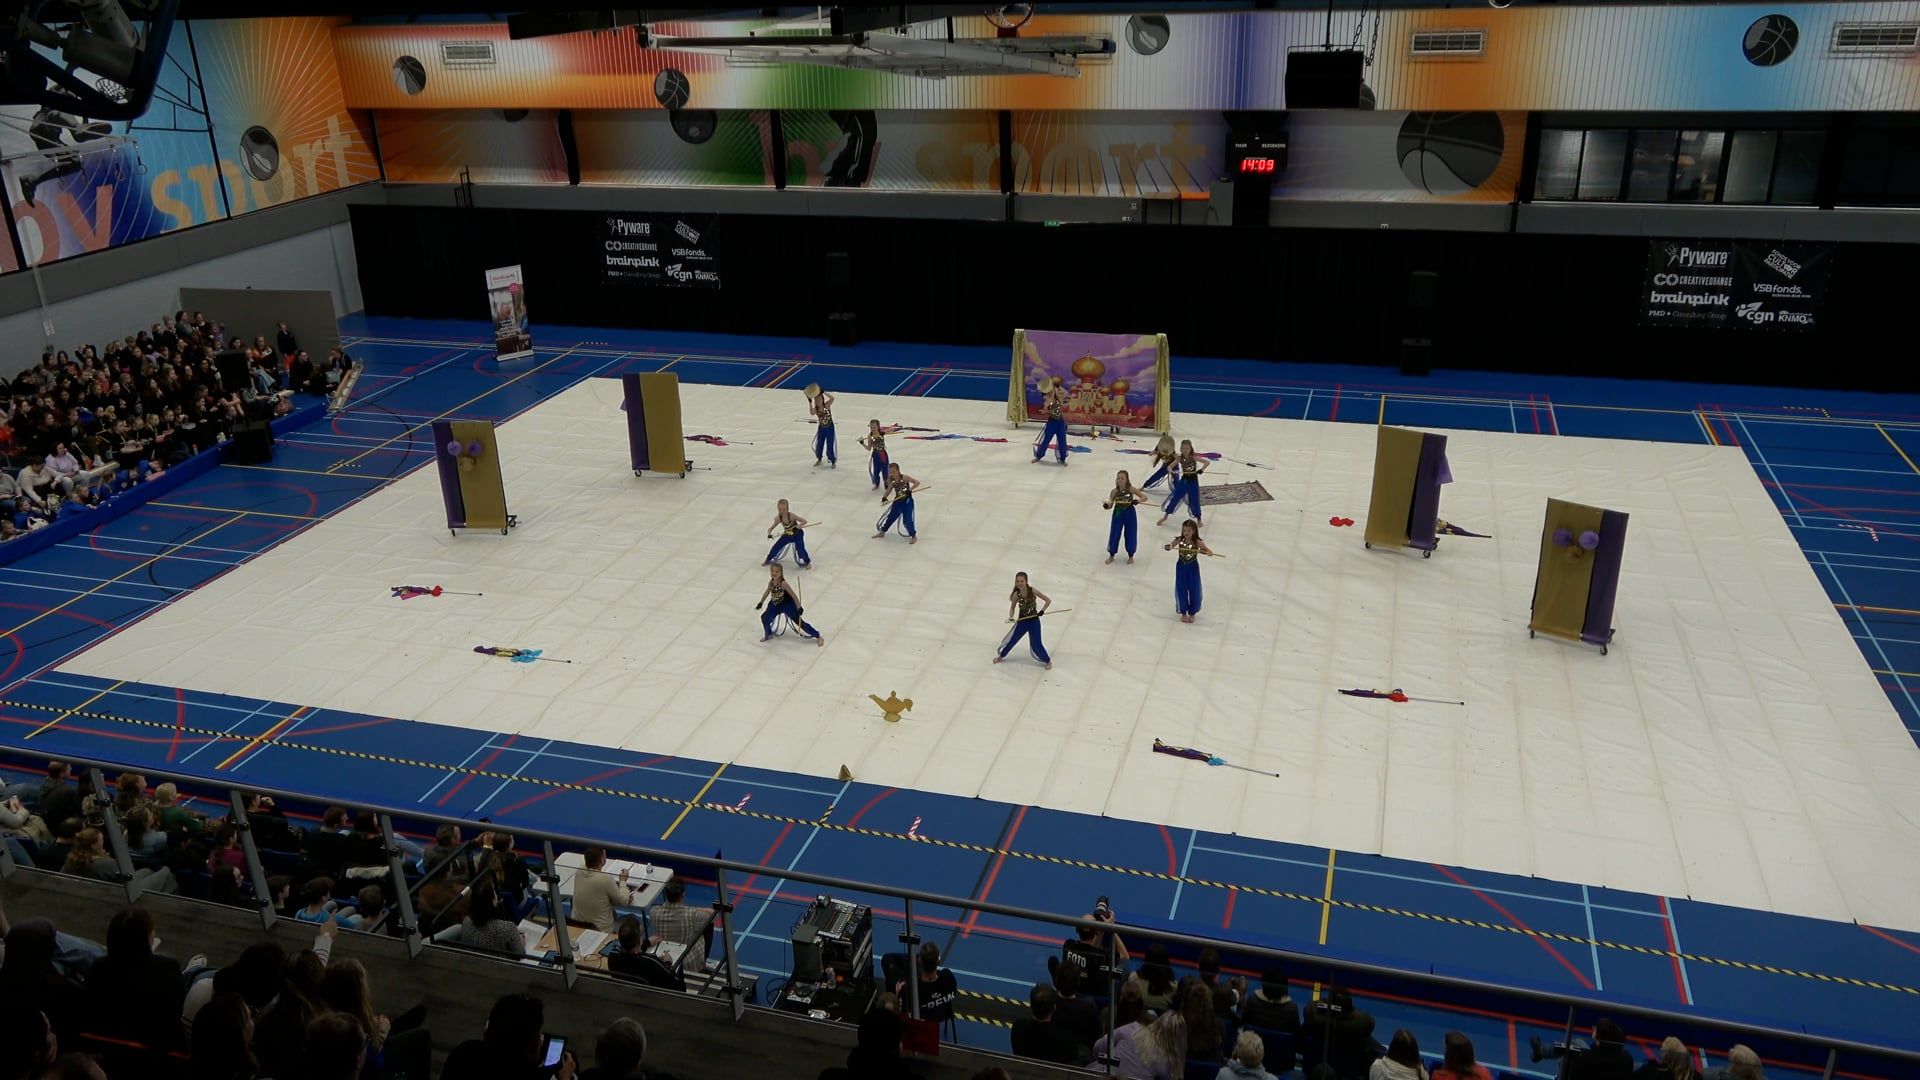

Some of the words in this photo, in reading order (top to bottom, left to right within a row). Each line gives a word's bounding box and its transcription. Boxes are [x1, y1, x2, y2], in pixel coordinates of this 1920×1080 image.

[1241, 159, 1275, 171] 14:09
[617, 219, 651, 236] Pyware
[606, 254, 660, 268] brainpink
[1679, 247, 1728, 267] Pyware
[673, 270, 693, 282] cgn
[1653, 273, 1679, 286] CO
[1650, 291, 1730, 306] brainpink
[1746, 311, 1775, 325] cgn
[1067, 951, 1087, 968] FOTO
